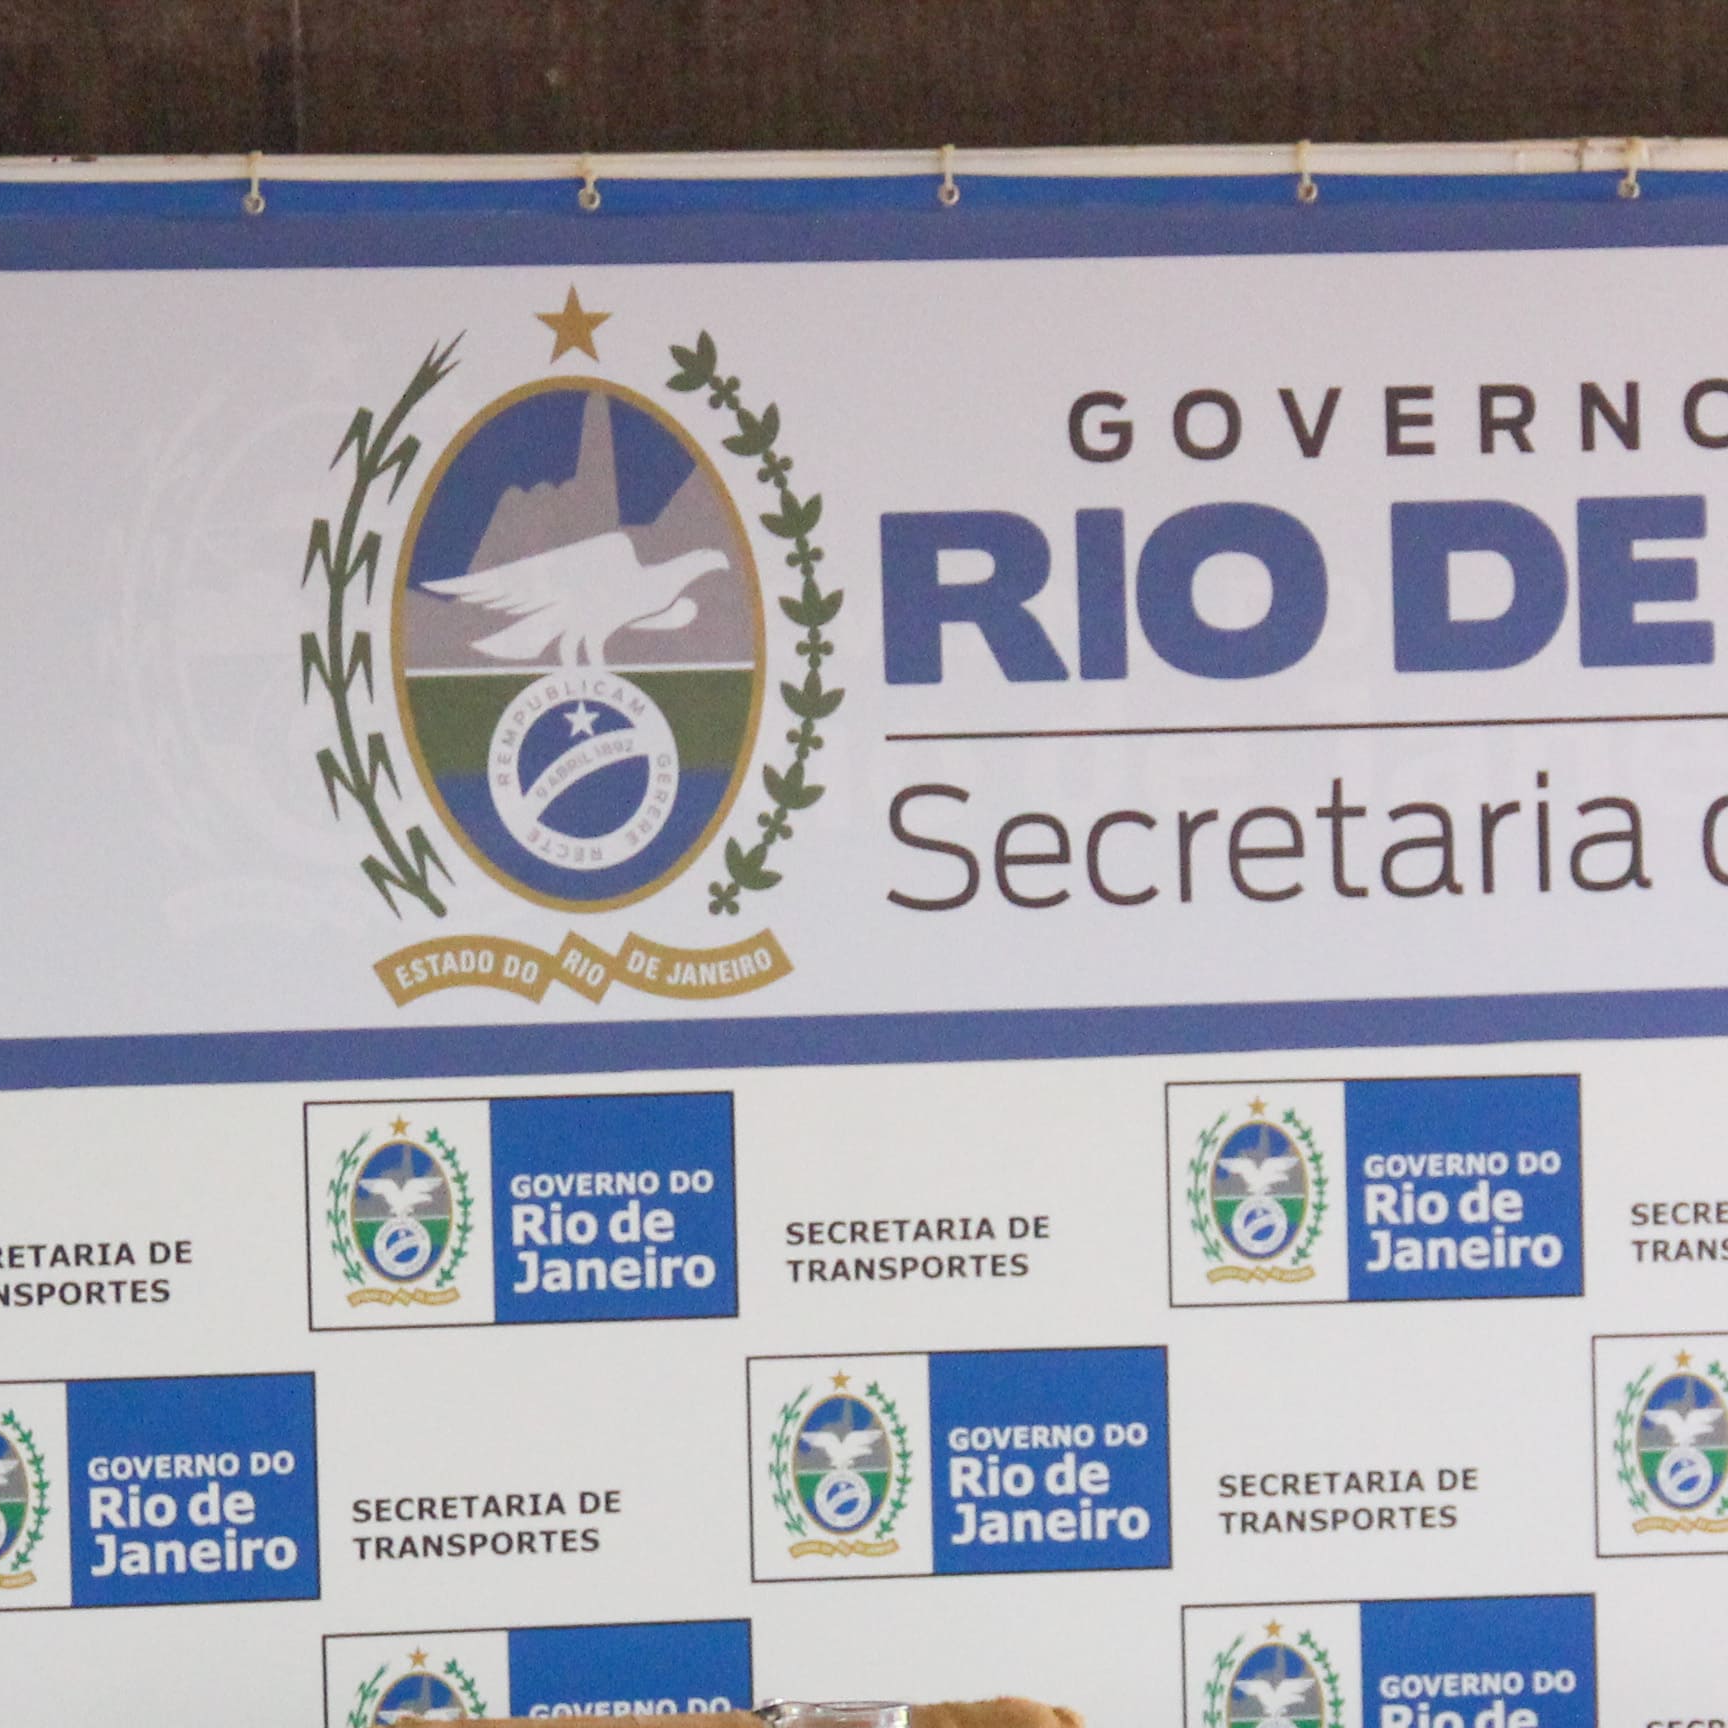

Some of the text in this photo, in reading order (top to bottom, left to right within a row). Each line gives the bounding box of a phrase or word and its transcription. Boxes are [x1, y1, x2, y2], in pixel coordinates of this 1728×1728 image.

[880, 501, 1328, 685] RIO
[1390, 495, 1715, 673] DE
[886, 770, 1653, 912] Secretaria
[394, 948, 773, 990] ESTADO DO RIO DE JANEIRO
[1364, 1151, 1561, 1179] GOVERNO DO
[510, 1170, 714, 1200] GOVERNO DO
[1364, 1180, 1523, 1225] Rio de
[512, 1199, 674, 1246] Rio de
[786, 1216, 1049, 1246] SECRETARIA DE
[150, 1241, 192, 1264] DE
[1366, 1225, 1563, 1272] Janeiro
[514, 1245, 716, 1293] Janeiro
[786, 1254, 1028, 1282] TRANSPORTES
[948, 1422, 1148, 1452] GOVERNO DO
[88, 1450, 295, 1481] GOVERNO DO
[950, 1452, 1109, 1498] Rio de
[1219, 1468, 1477, 1498] SECRETARIA DE
[89, 1481, 255, 1529] Rio de
[353, 1490, 620, 1523] SECRETARIA DE
[952, 1497, 1150, 1544] Janeiro
[1219, 1505, 1457, 1534] TRANSPORTES
[91, 1528, 298, 1577] Janeiro
[353, 1528, 599, 1560] TRANSPORTES
[1379, 1669, 1577, 1699] GOVERNO DO
